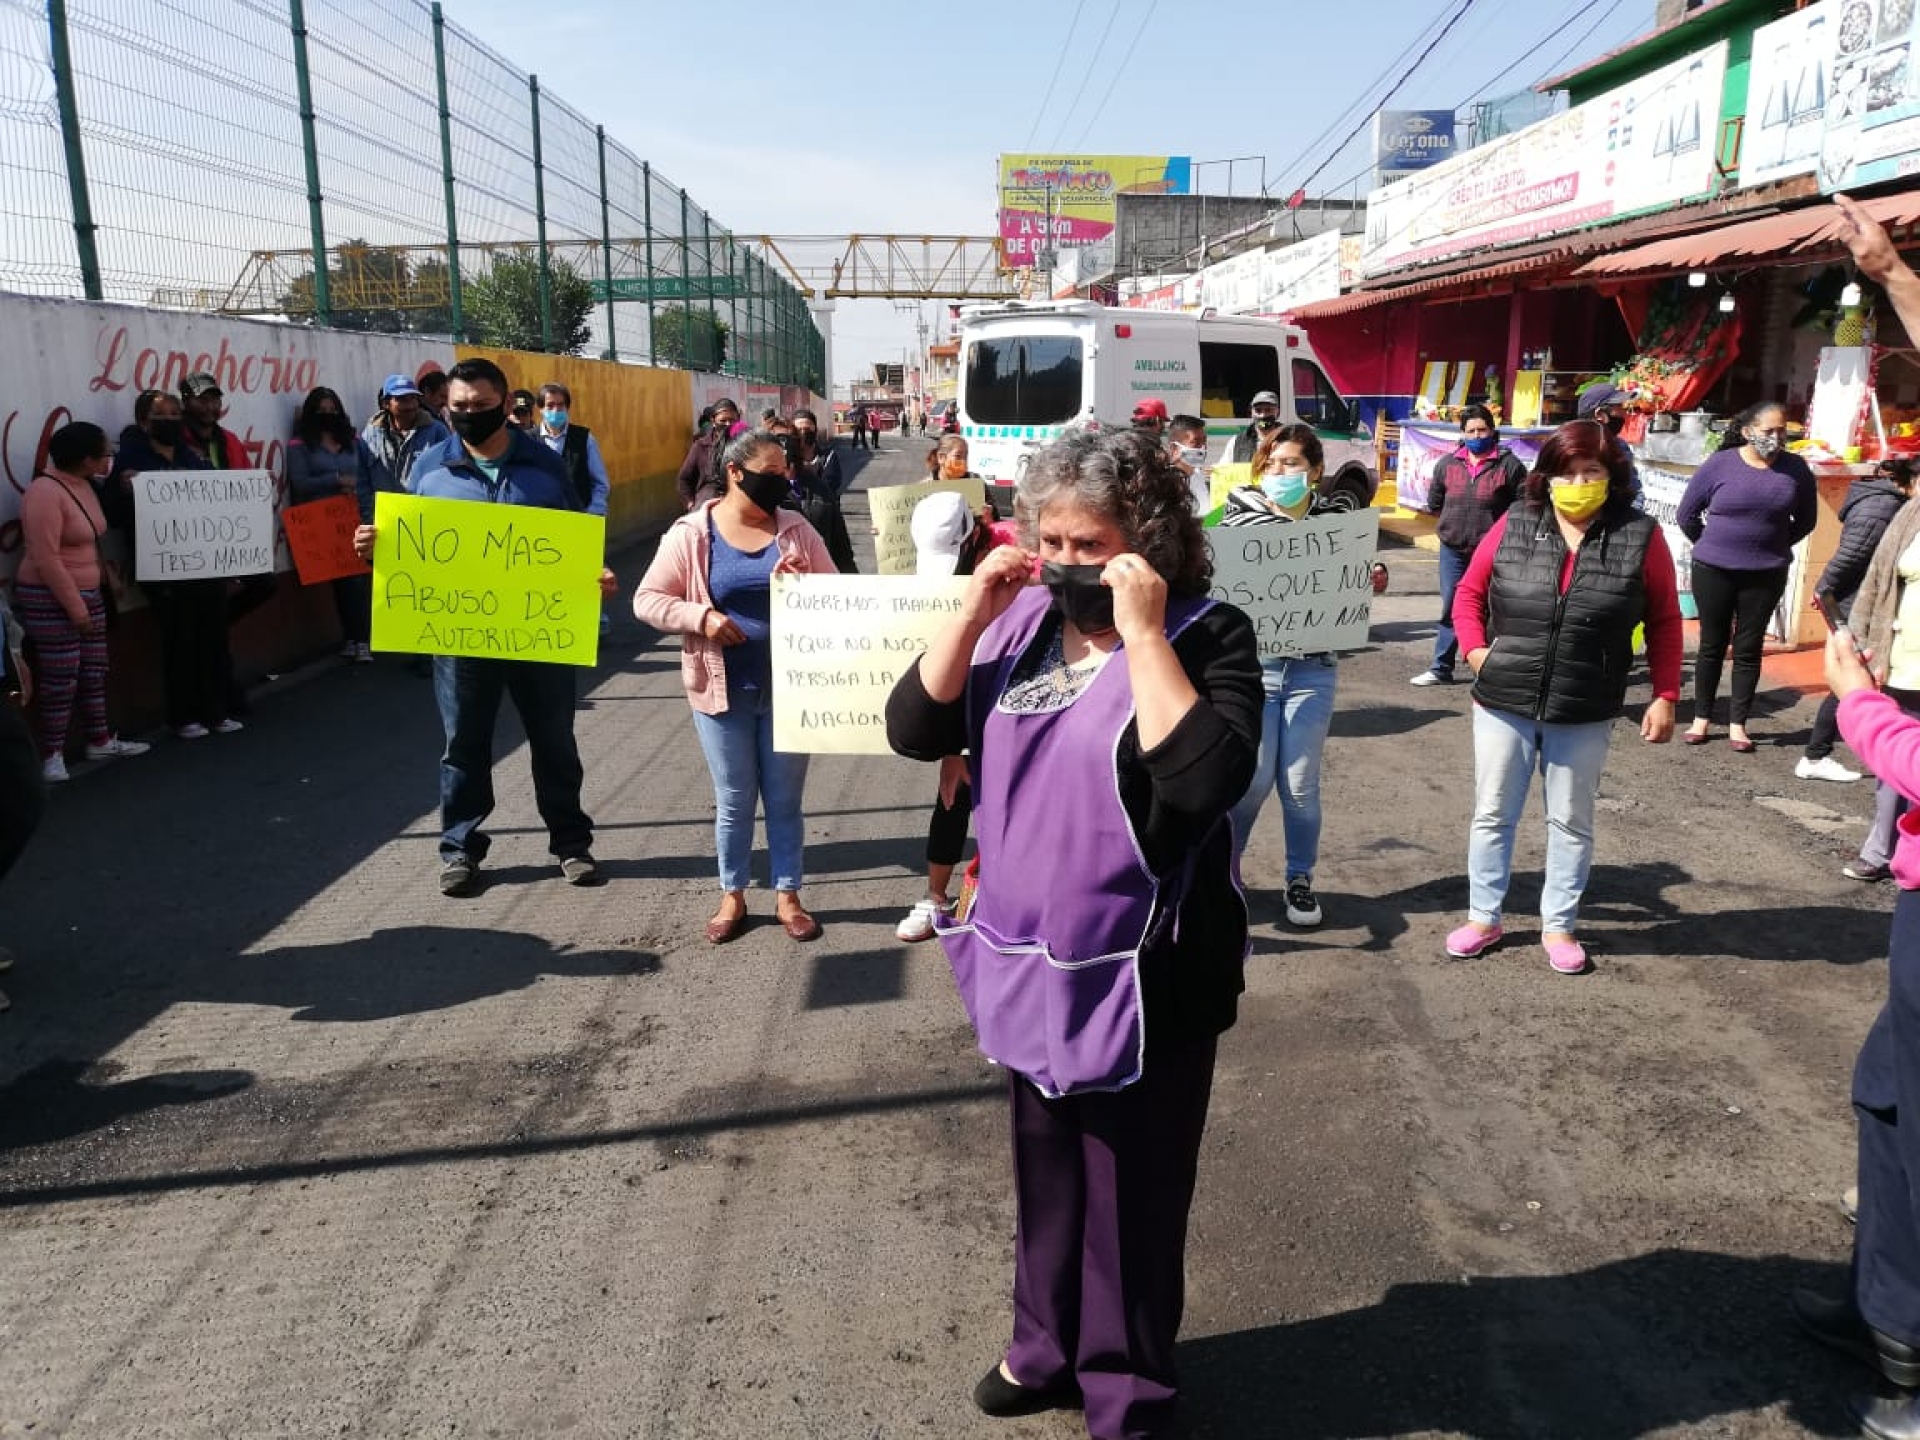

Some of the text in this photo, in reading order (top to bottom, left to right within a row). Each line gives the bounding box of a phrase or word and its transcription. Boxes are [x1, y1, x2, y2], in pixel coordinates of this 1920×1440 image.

[1386, 134, 1449, 151] Corona
[1021, 217, 1033, 234] A
[1037, 217, 1048, 234] 5
[1006, 238, 1027, 254] DE
[612, 280, 667, 295] ALIMENOS
[1134, 359, 1188, 372] AMBULANCIA
[146, 478, 272, 504] COMERCIANTES
[152, 516, 252, 546] UNIDOS
[397, 512, 460, 564] NO
[482, 522, 563, 571] MAS
[152, 546, 268, 574] TRES MARIAS
[385, 571, 568, 621] ABUSO DE
[785, 591, 963, 613] QUEREMOS TRABAJA
[1211, 580, 1264, 606] OS.
[1255, 609, 1326, 636] EYEN
[416, 621, 576, 653] AUTORIDAD
[844, 636, 872, 652] NO
[882, 637, 930, 652] NOS
[1257, 639, 1304, 657] HOS.
[786, 669, 895, 687] PERSIGA LA
[800, 709, 886, 729] NACION
